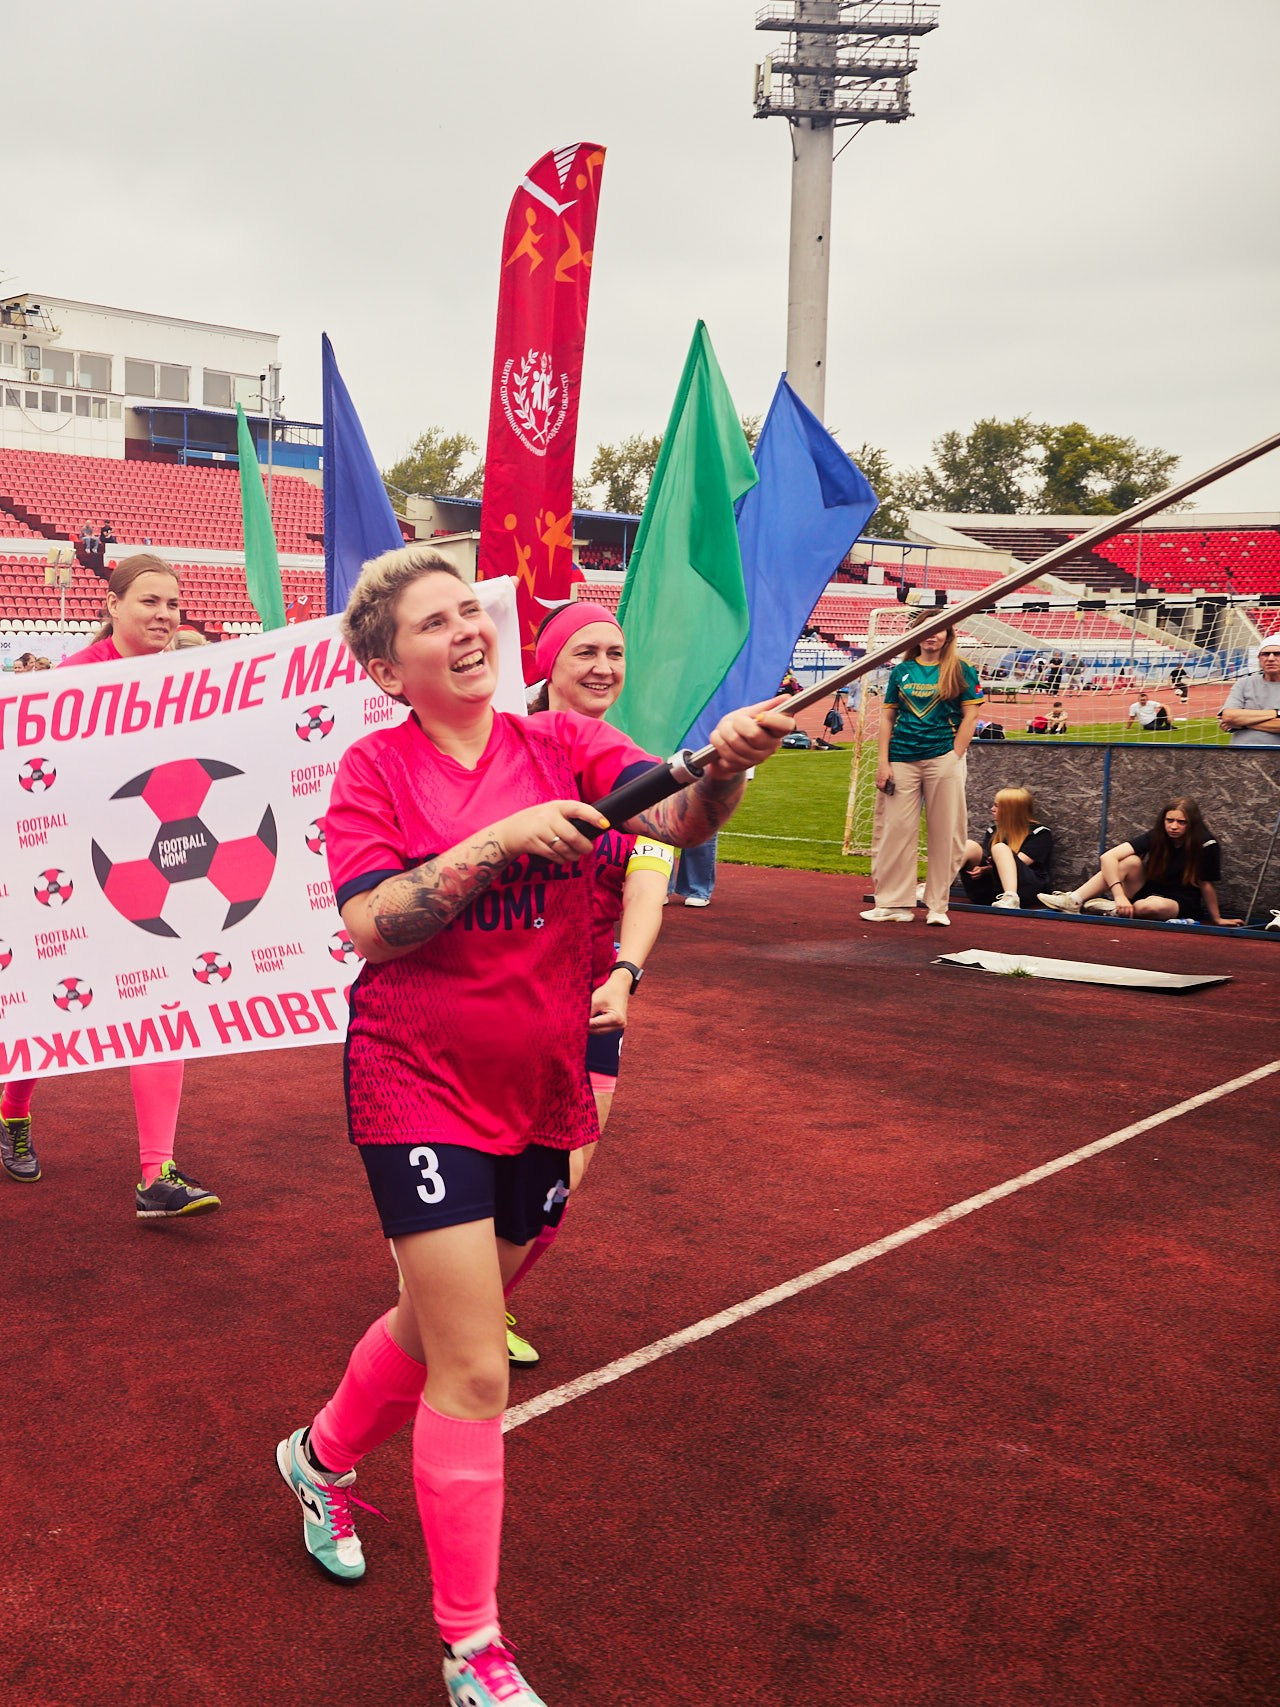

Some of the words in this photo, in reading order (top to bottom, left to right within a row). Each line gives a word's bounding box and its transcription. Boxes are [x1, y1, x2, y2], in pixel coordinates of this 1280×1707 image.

[501, 358, 514, 385] ЦЕНТР
[560, 372, 569, 410] ОБЛАСТИ
[281, 638, 381, 700] МА
[364, 708, 393, 725] MOM!
[290, 760, 340, 783] FOOTBAL
[291, 779, 322, 798] MOM!
[16, 812, 69, 834] FOOTBALL
[19, 831, 48, 849] MOM!
[157, 832, 207, 855] FOOTBALL
[160, 850, 188, 869] MOM!
[306, 880, 333, 897] FOOT
[309, 894, 336, 911] MOM
[34, 926, 89, 947] FOOTBALL
[37, 943, 67, 960] MOM!
[250, 941, 305, 962] FOOTBALL
[114, 966, 169, 986] FOOTBALL
[254, 958, 286, 974] MOM!
[117, 982, 148, 1000] MOM!
[208, 984, 352, 1045] НОВГ
[408, 1146, 446, 1204] 3
